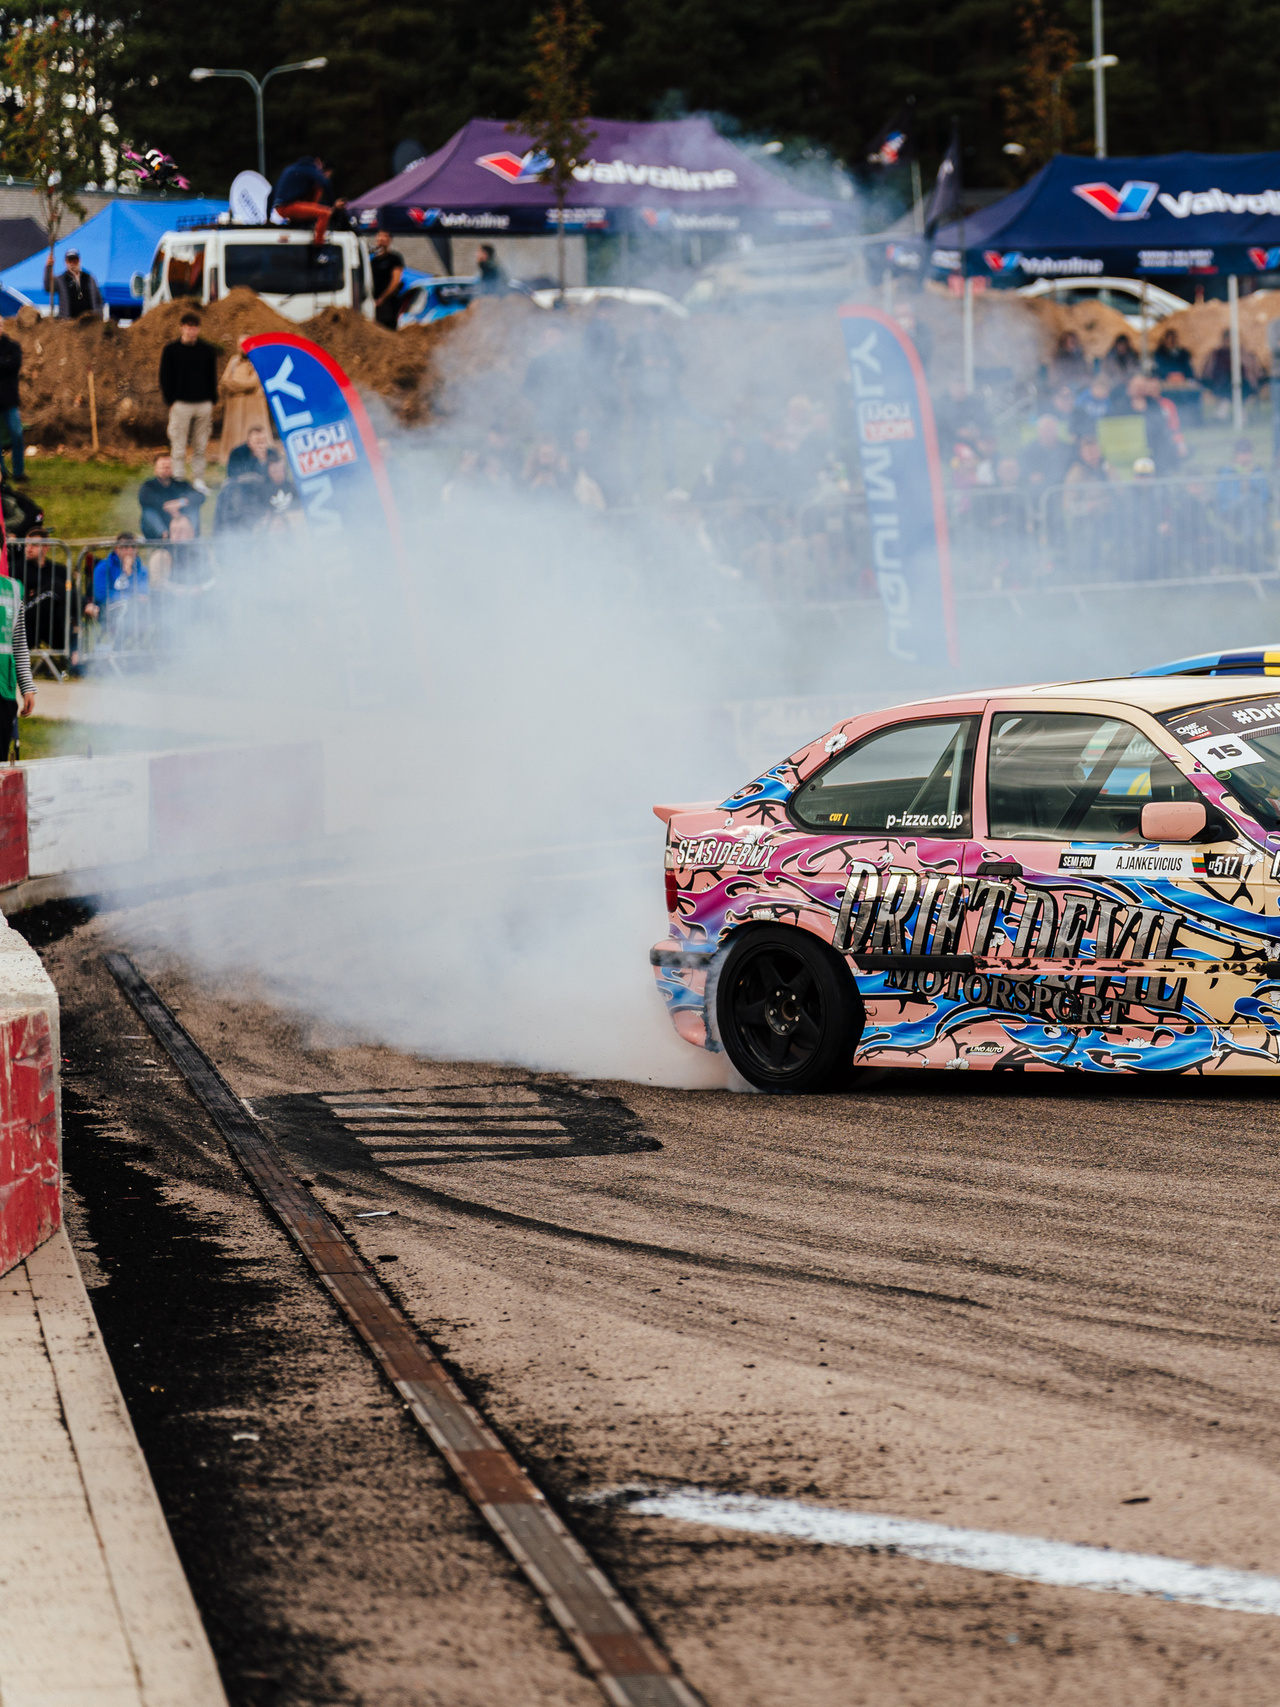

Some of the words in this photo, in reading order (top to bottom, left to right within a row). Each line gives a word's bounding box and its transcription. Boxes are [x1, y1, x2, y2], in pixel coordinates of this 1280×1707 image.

[1176, 722, 1200, 736] ONE
[1187, 725, 1209, 737] WAY
[1207, 744, 1243, 760] 15
[886, 811, 963, 829] p-izza.co.jp
[677, 839, 779, 868] SEASIDEBMX
[1062, 856, 1079, 867] SEMI
[1079, 857, 1093, 868] PRO
[1115, 856, 1183, 871] A.JANKEVICIUS
[1214, 856, 1240, 876] 517
[832, 860, 1017, 956] DRIFT
[1003, 884, 1188, 1011] DEVIL
[884, 968, 1131, 1028] MOTORSPORT
